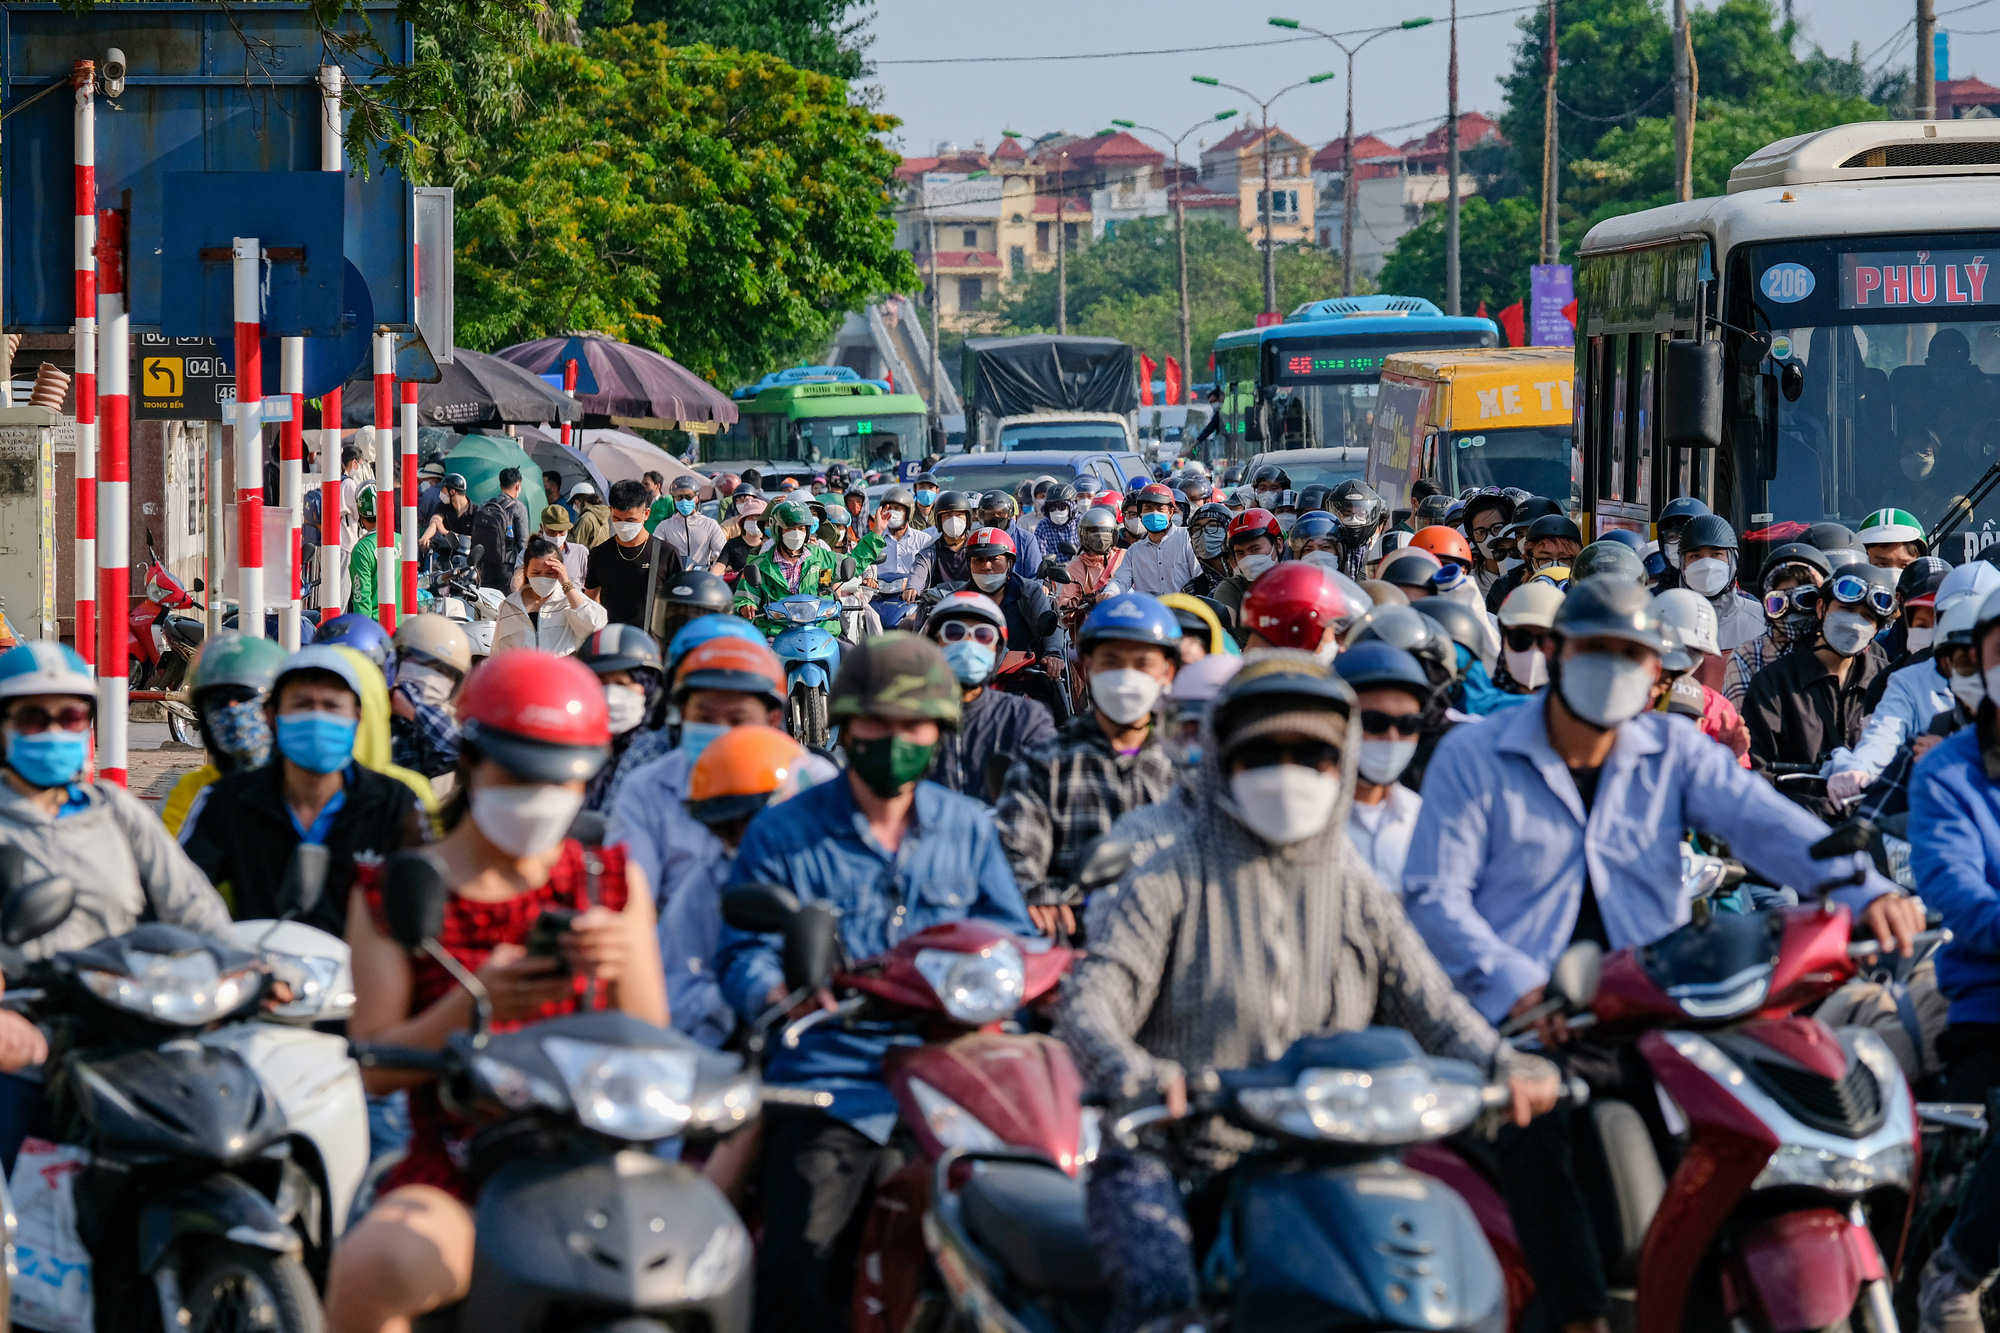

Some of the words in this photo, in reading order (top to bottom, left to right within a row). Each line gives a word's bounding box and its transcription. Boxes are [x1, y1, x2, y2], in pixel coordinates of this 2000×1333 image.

[1768, 268, 1807, 298] 206
[1856, 250, 1937, 304] PHỦ
[1945, 255, 1990, 303] LÝ
[189, 360, 210, 374] 04
[169, 399, 184, 409] BẾN
[218, 386, 237, 399] 48
[1476, 384, 1523, 420] XE
[1964, 518, 2000, 564] ĐỒ
[353, 573, 363, 603] Grab
